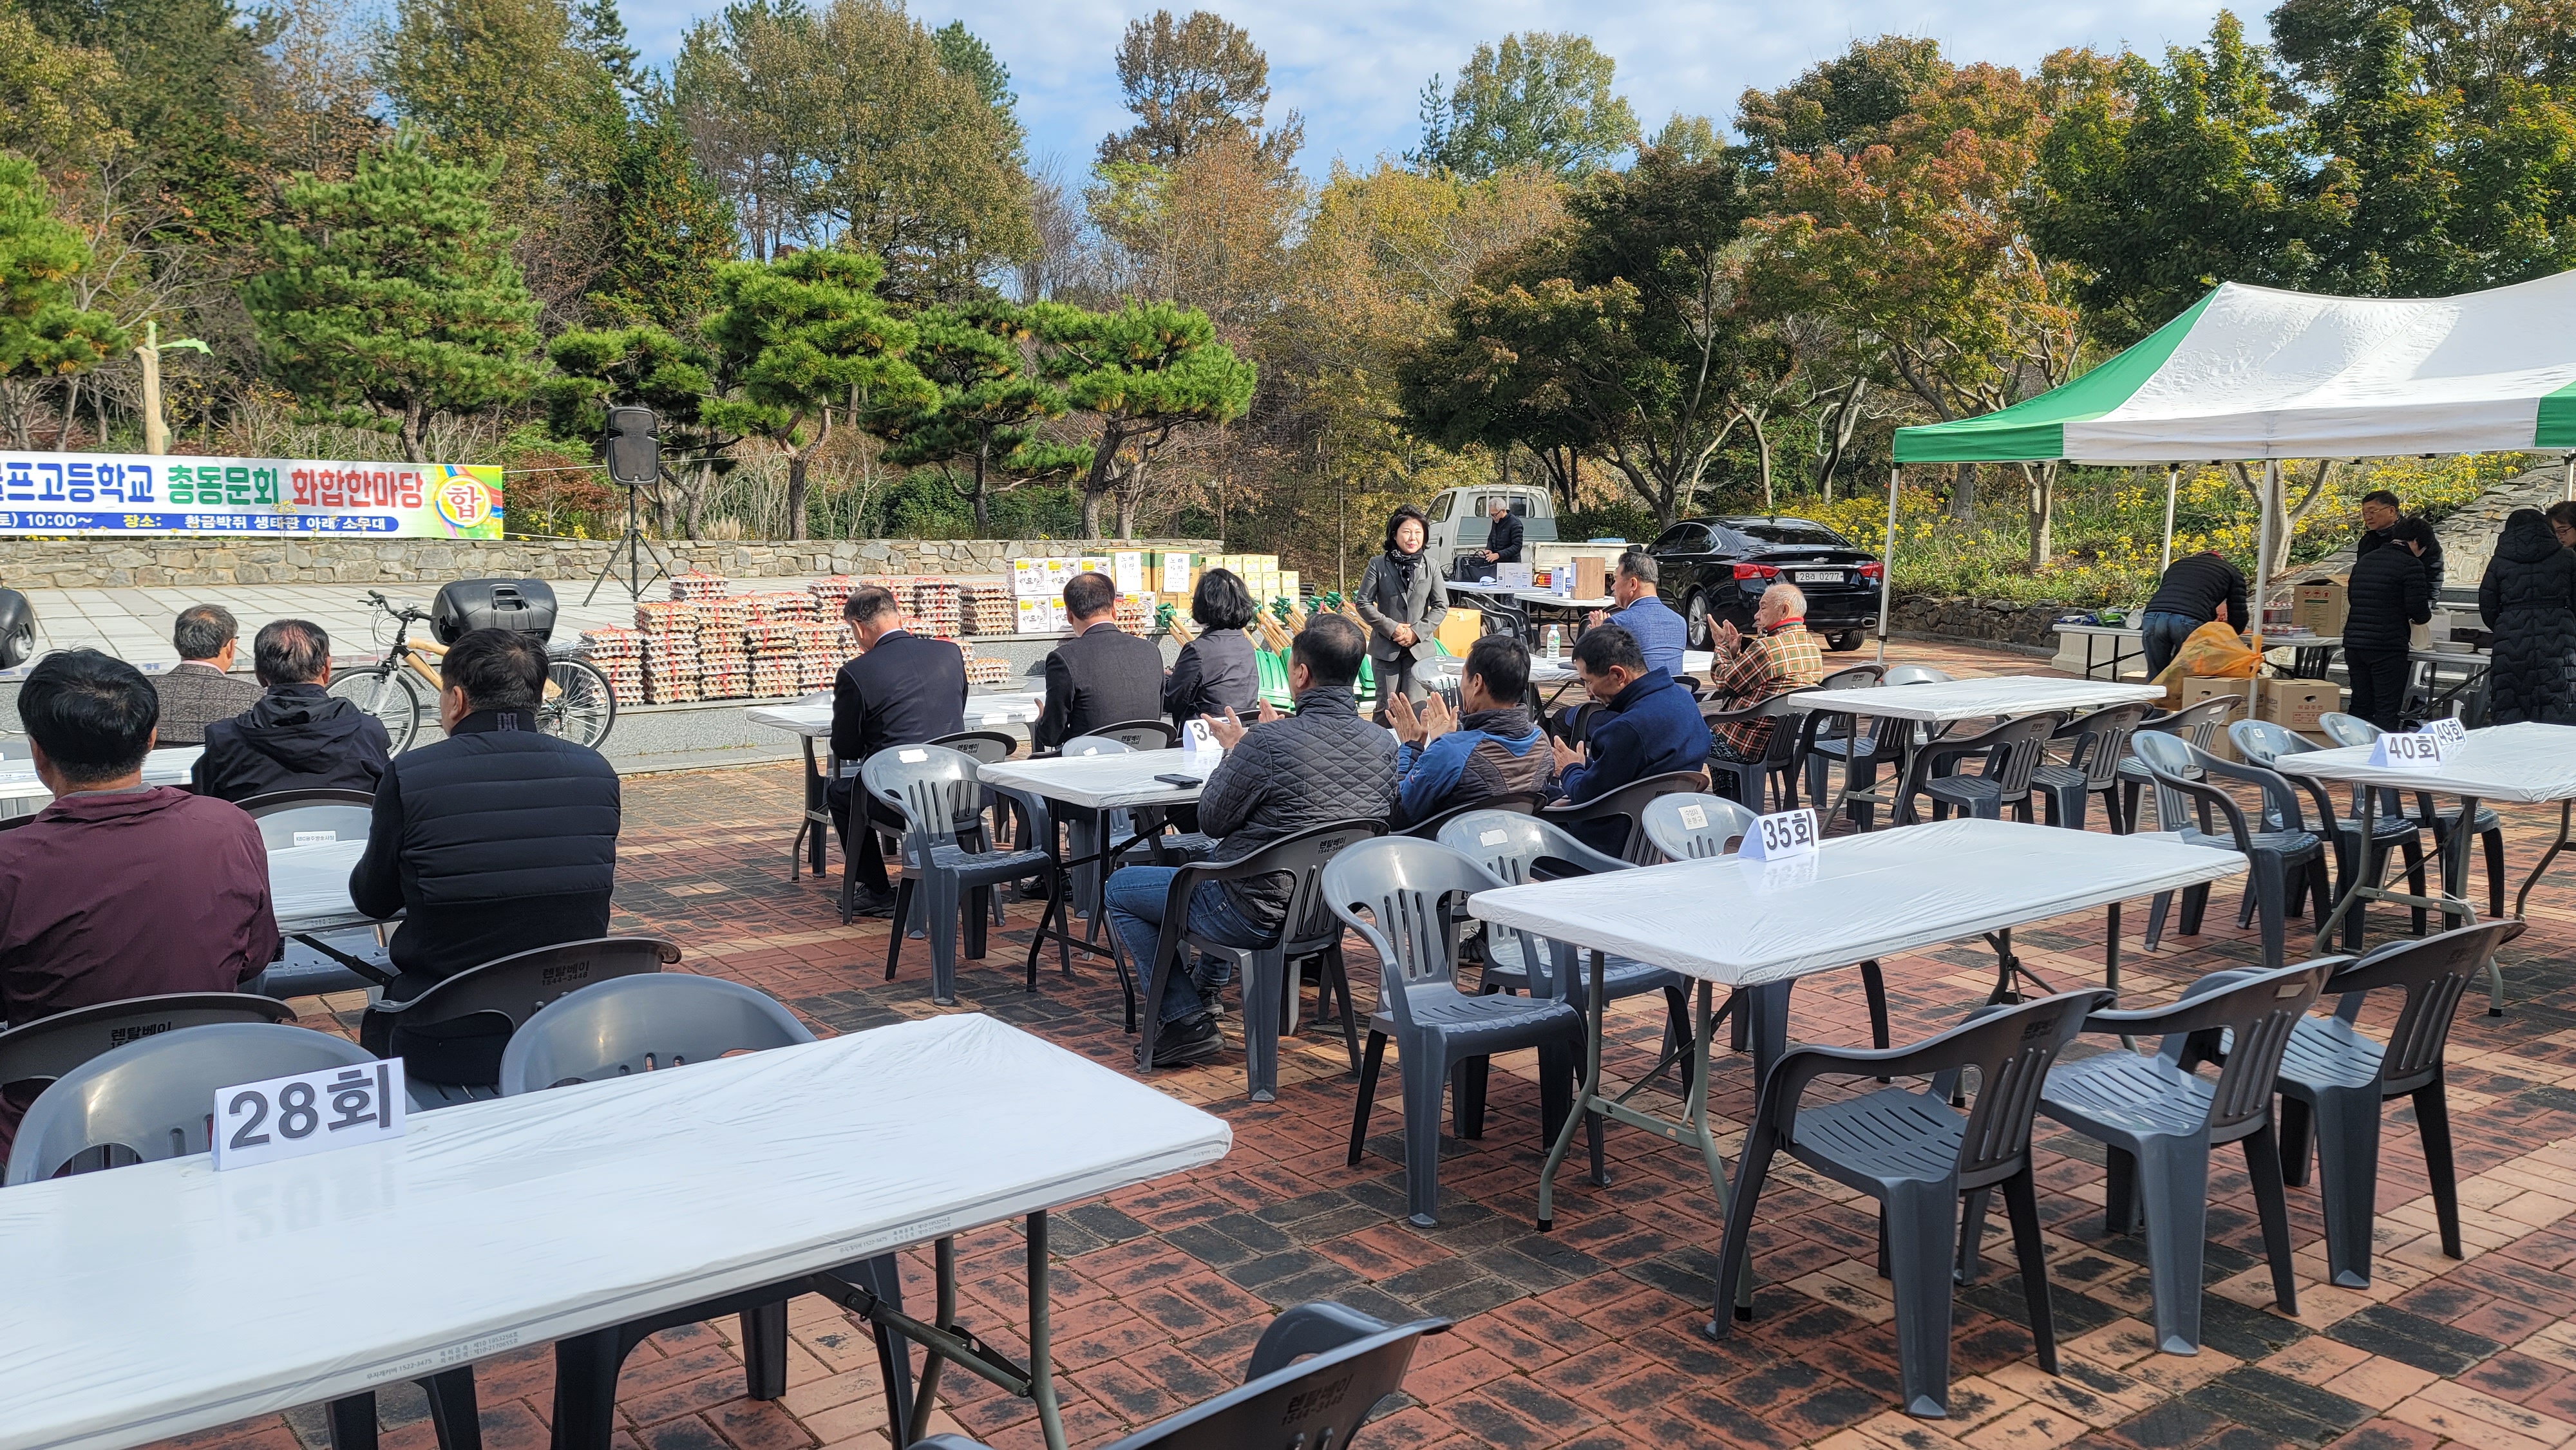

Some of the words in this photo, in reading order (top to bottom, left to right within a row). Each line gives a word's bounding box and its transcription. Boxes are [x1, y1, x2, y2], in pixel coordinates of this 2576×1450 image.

[0, 463, 155, 503] 프고등학교
[168, 464, 279, 505] 총동문회
[291, 468, 423, 509] 화합한마당
[446, 486, 482, 519] 합
[26, 514, 93, 527] 10:00~
[123, 514, 162, 528] 장소:
[184, 514, 247, 529] 황금박쥐
[254, 516, 300, 530] 생태관
[306, 517, 336, 531] 아래
[2436, 719, 2466, 743] 49회
[2389, 735, 2440, 762] 40회
[1319, 835, 1347, 849] 렌탈베이
[1763, 811, 1815, 851] 35회
[543, 960, 589, 979] 렌탈베이
[111, 1021, 171, 1041] 렌탈베이
[229, 1063, 390, 1150] 28회
